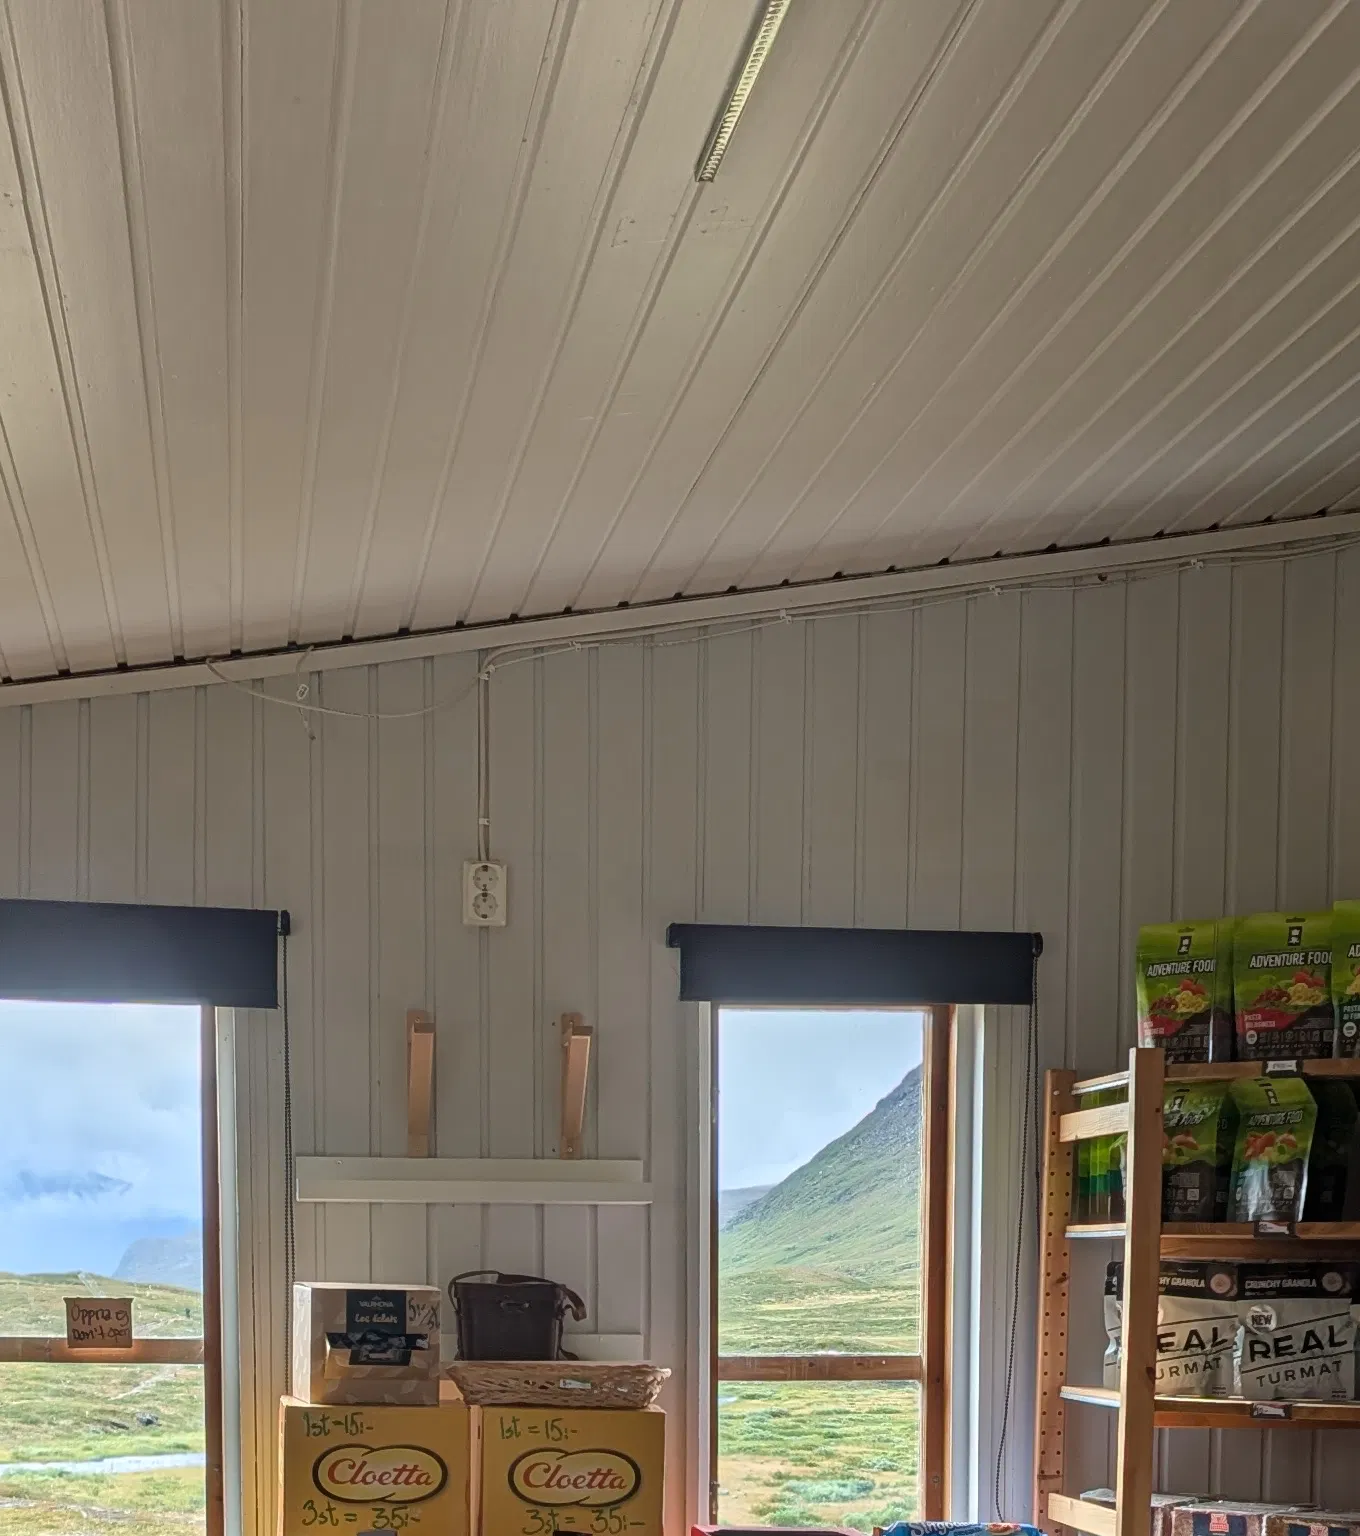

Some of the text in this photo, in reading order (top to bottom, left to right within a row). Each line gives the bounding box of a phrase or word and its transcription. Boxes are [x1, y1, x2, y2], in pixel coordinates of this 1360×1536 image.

[1147, 960, 1192, 977] ADVENTURE
[1250, 953, 1305, 968] ADVENTURE
[1251, 1312, 1274, 1327] NEW
[1158, 1325, 1230, 1354] EAL
[1248, 1325, 1348, 1362] REAL
[1155, 1357, 1222, 1382] URMAT
[1256, 1360, 1342, 1387] TURMAT
[327, 1458, 436, 1487] Cloetta
[522, 1462, 628, 1491] Cloetta
